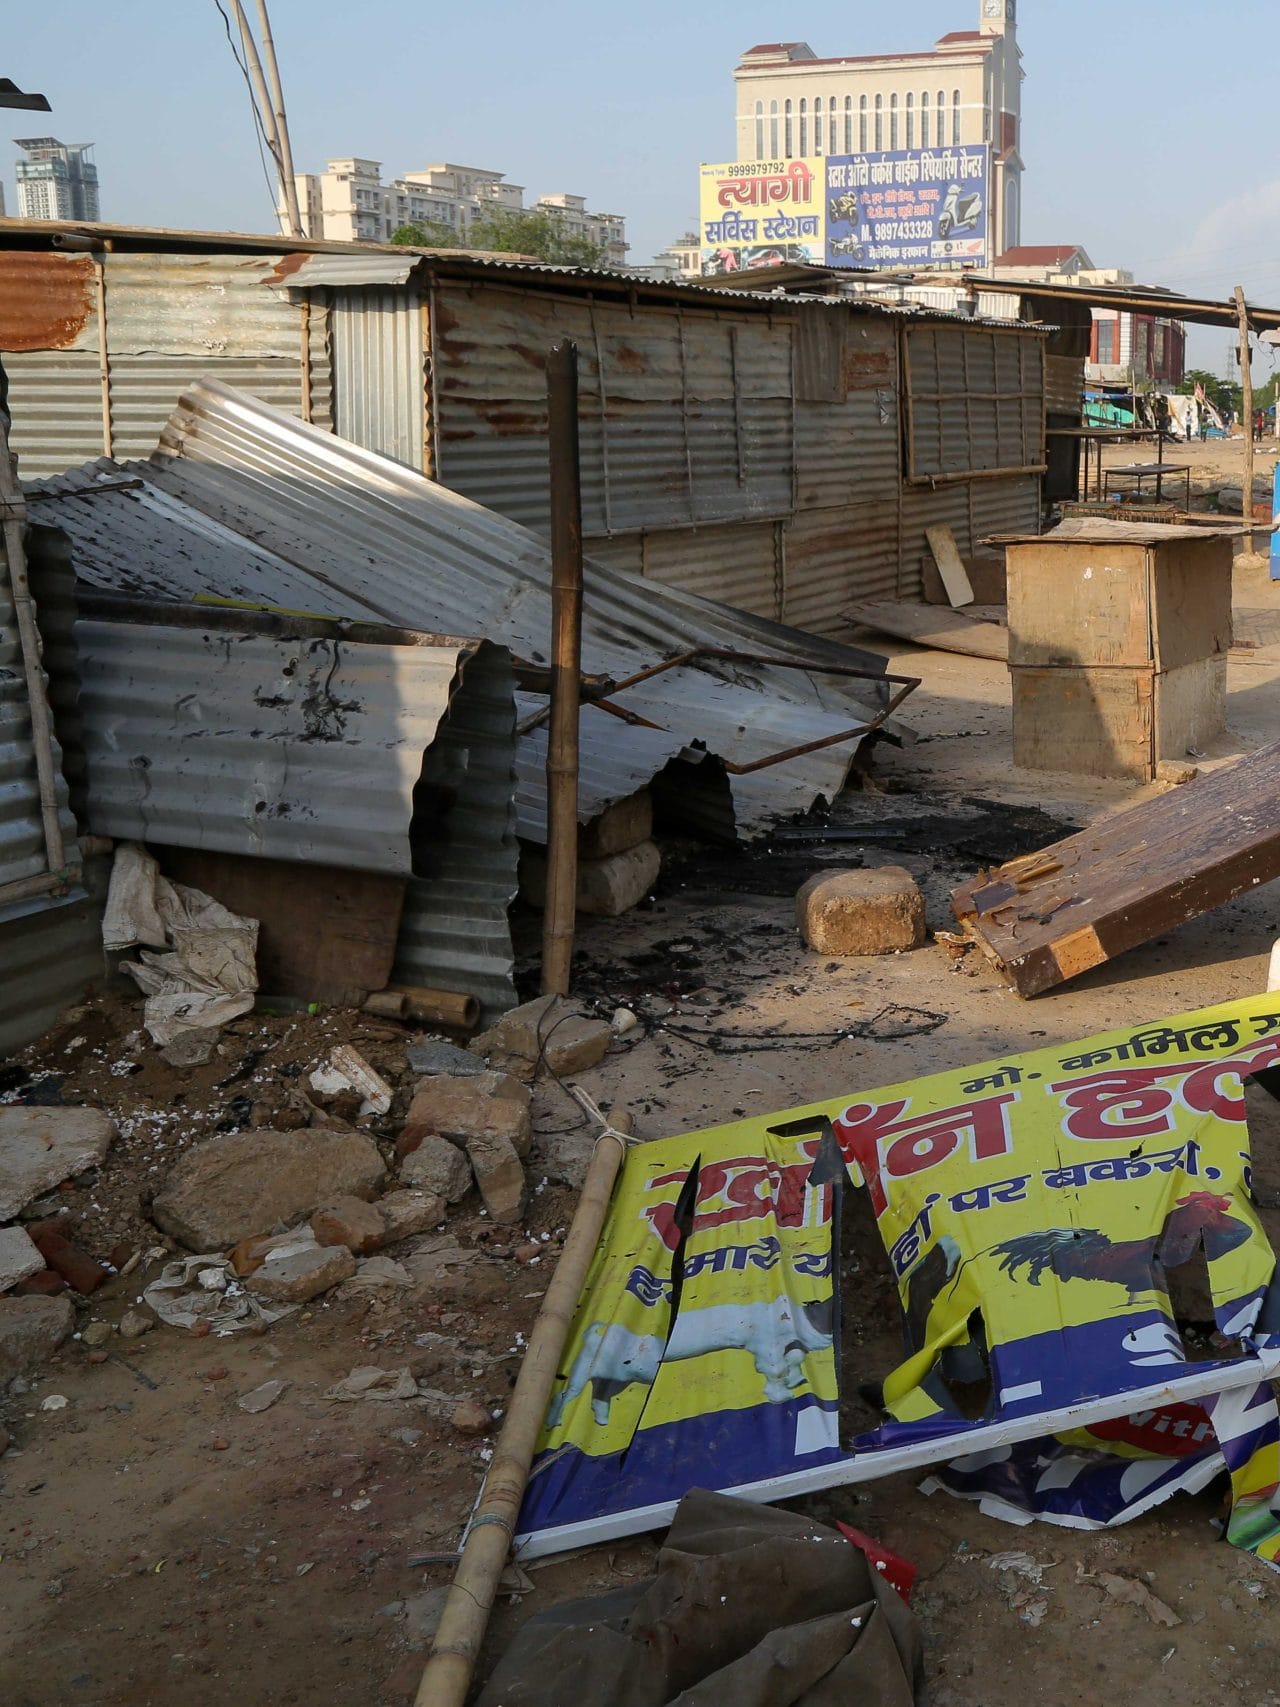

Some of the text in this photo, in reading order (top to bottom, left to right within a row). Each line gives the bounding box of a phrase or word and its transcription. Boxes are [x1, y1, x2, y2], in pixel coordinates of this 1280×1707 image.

[716, 161, 815, 208] त्यागी
[828, 163, 846, 188] स्टार
[847, 155, 869, 187] ऑटो
[704, 209, 820, 244] सर्विस स्टेशन
[960, 1064, 1042, 1095] मो.
[1058, 1018, 1241, 1072] कामिल
[947, 1173, 1033, 1213] पर
